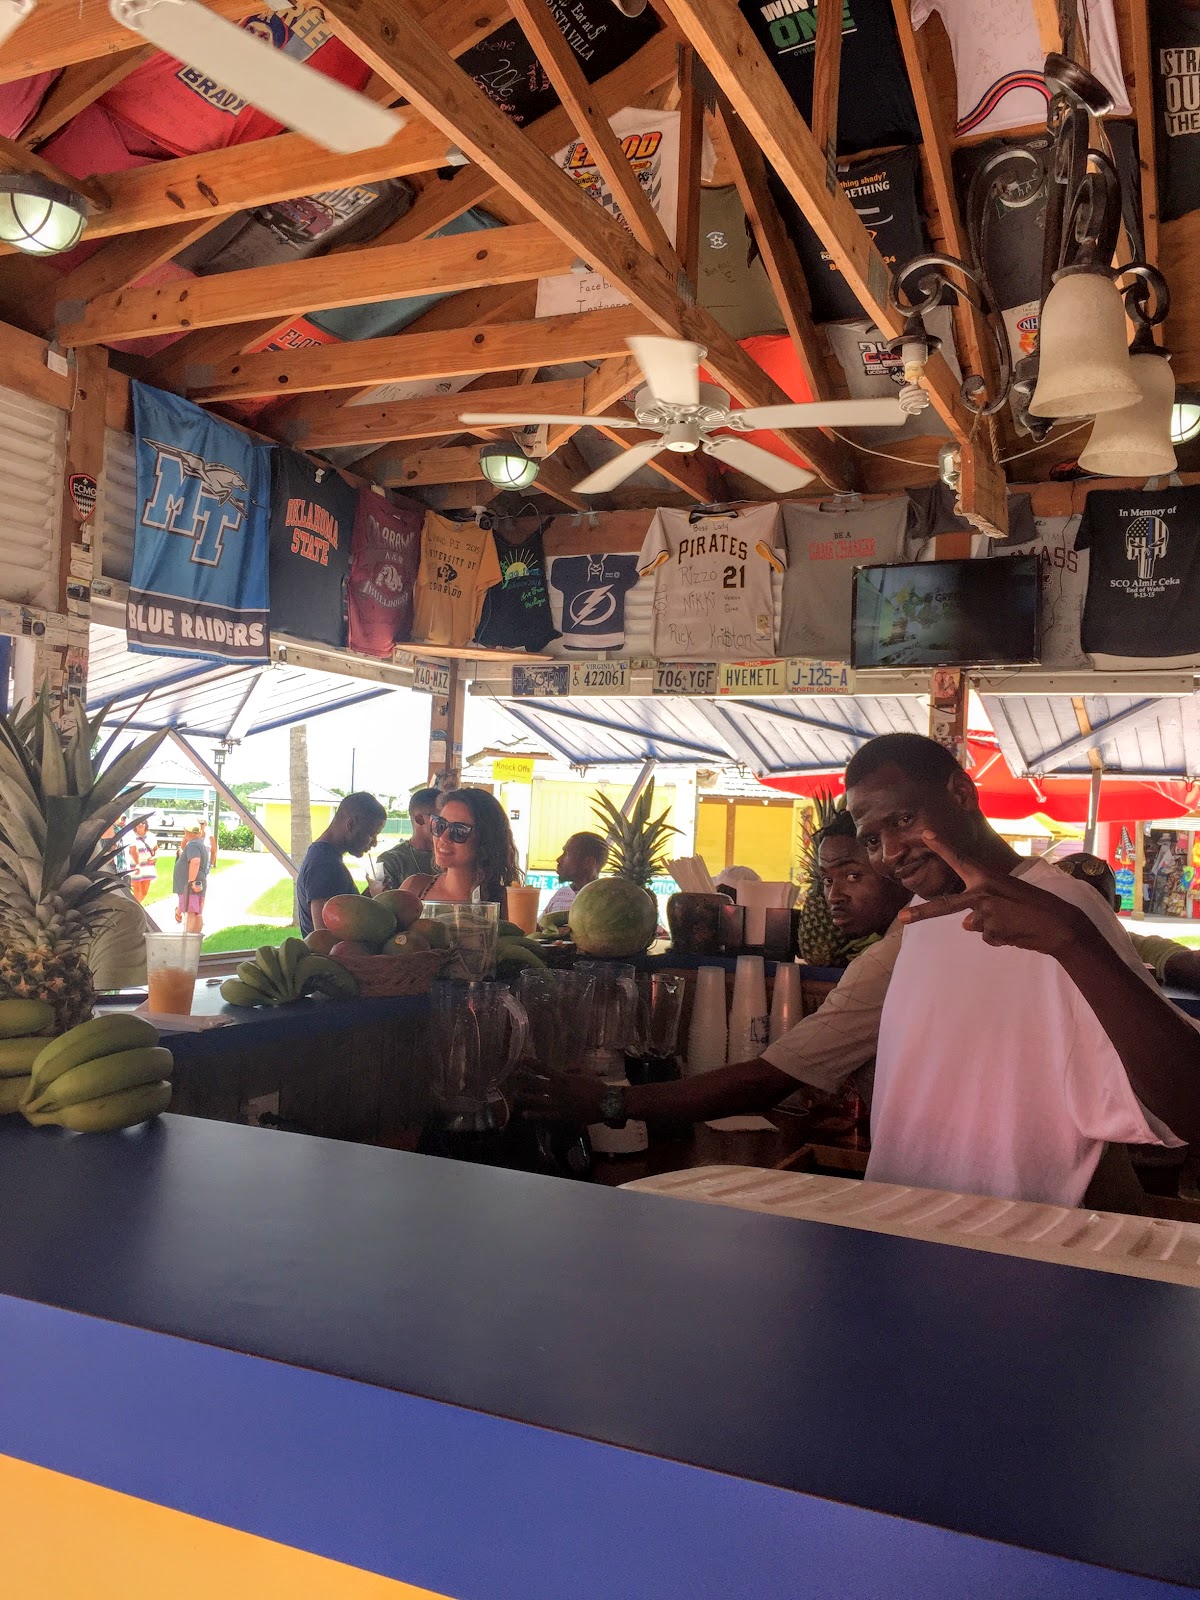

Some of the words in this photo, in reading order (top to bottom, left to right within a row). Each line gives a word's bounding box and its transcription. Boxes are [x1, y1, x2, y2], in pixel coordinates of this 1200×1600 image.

[571, 3, 587, 24] Eat
[582, 20, 593, 33] at
[760, 0, 809, 22] WIN
[277, 0, 333, 50] REE
[566, 29, 595, 61] VILLA
[1163, 50, 1200, 76] STR
[183, 66, 246, 111] BRADY
[1165, 75, 1200, 113] OU
[1168, 112, 1200, 134] THE
[860, 171, 887, 184] shady?
[1021, 317, 1039, 330] NH
[1119, 509, 1129, 517] In
[1130, 508, 1166, 517] Memory
[1167, 506, 1177, 514] of
[285, 498, 339, 550] OKLAHOMA
[291, 527, 330, 566] STATE
[834, 532, 844, 540] BE
[845, 531, 852, 539] A
[678, 533, 748, 565] PIRATES
[723, 565, 745, 588] 21
[1110, 580, 1130, 588] SCO
[1132, 578, 1158, 588] Almir
[1159, 577, 1180, 587] Ceka
[1134, 591, 1156, 599] 9-13-15
[1147, 585, 1165, 593] Watch
[128, 602, 175, 636] BLUE
[181, 612, 264, 647] RAIDERS
[586, 663, 616, 671] VIRGINIA
[726, 668, 779, 686] HVEMETL
[583, 670, 625, 687] 422061
[496, 762, 515, 770] Knock
[517, 764, 531, 773] Offs
[528, 874, 549, 889] THE
